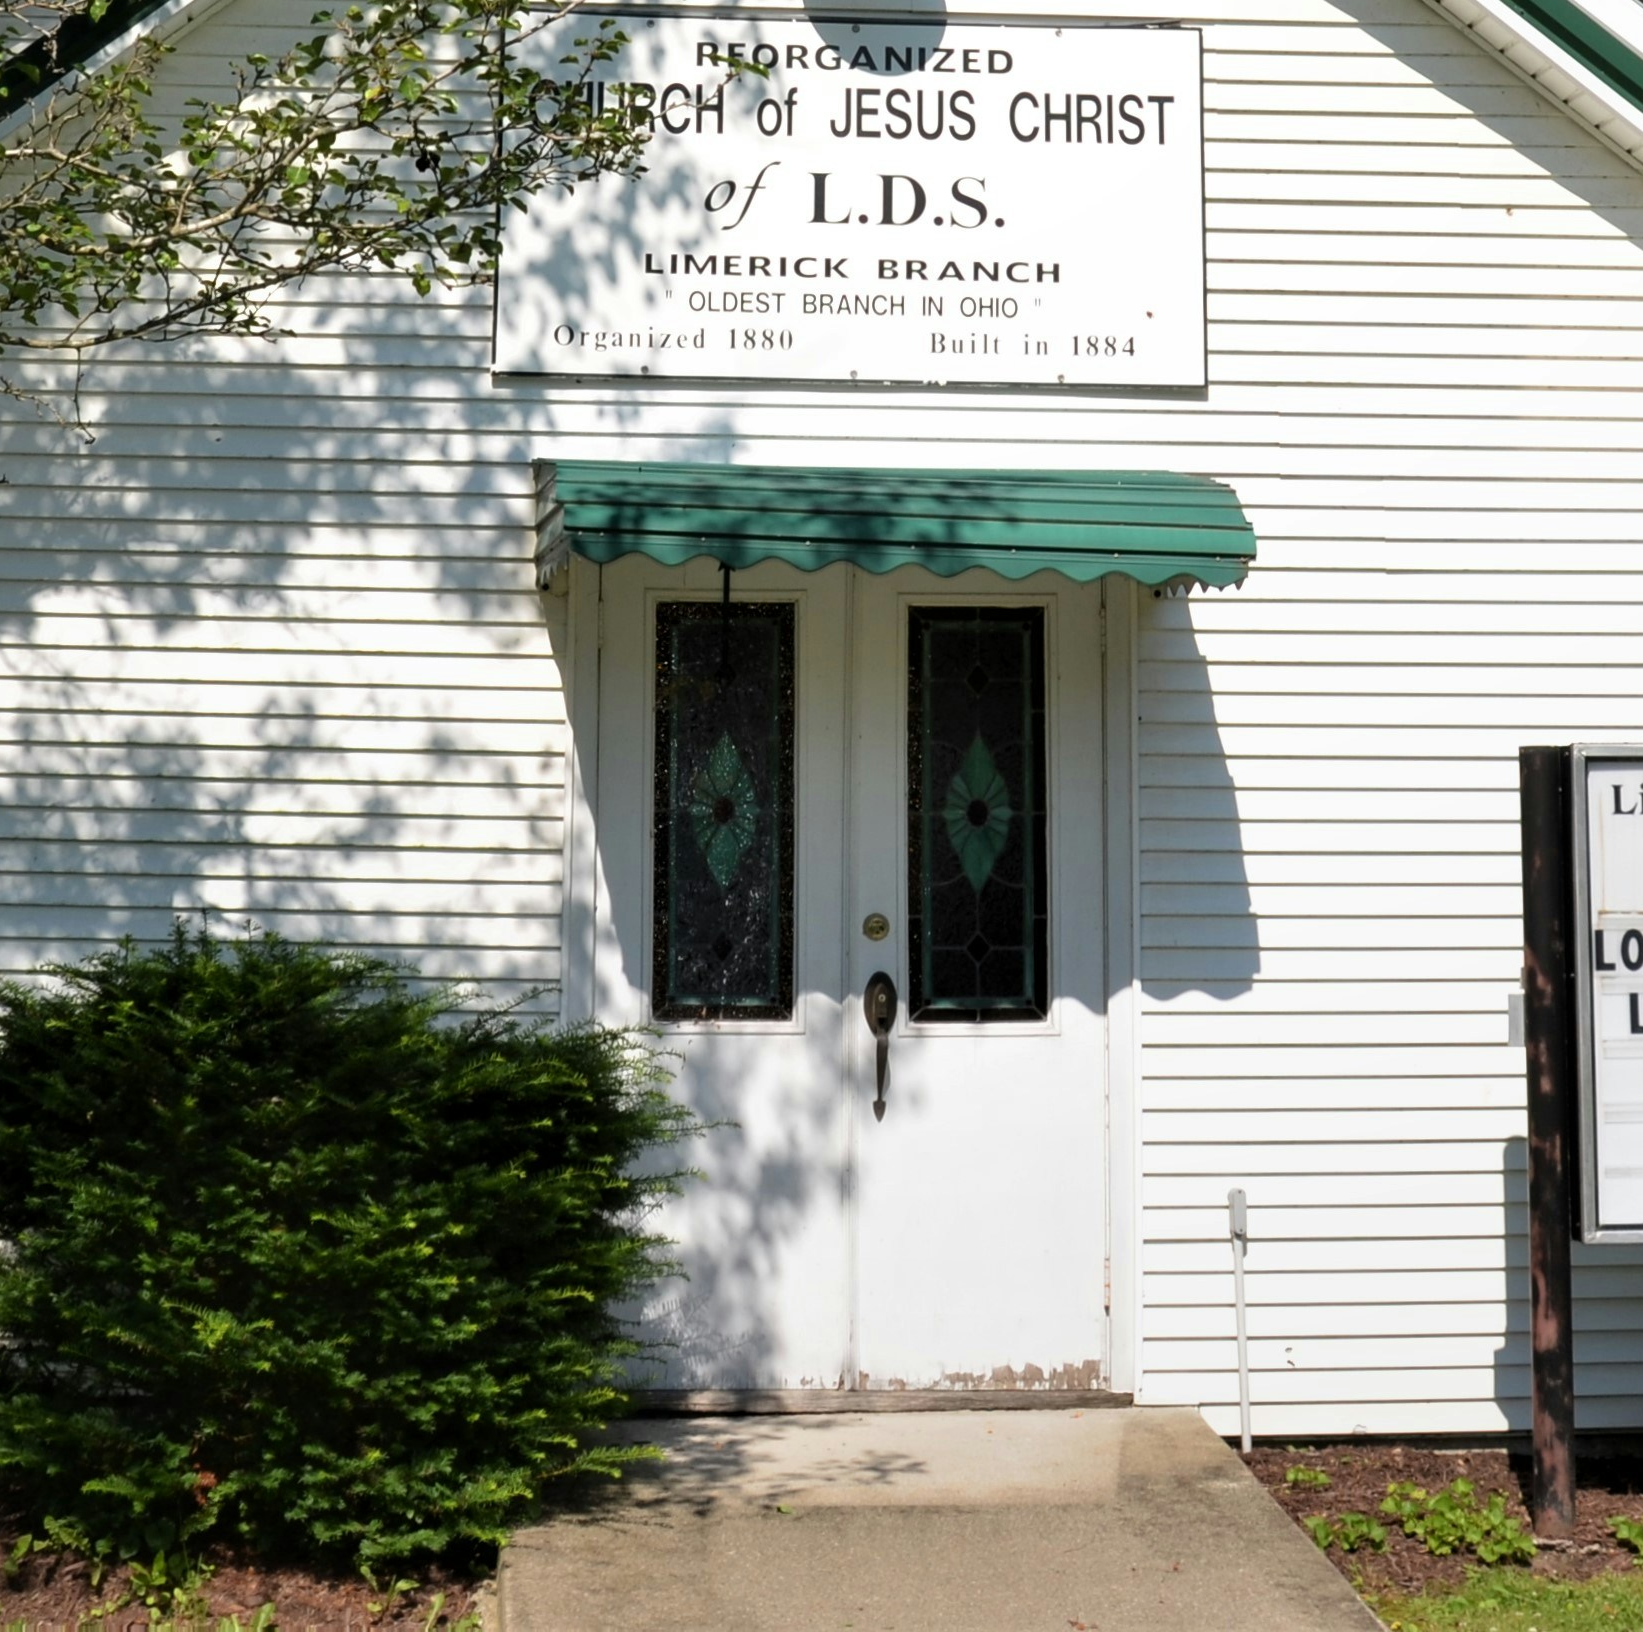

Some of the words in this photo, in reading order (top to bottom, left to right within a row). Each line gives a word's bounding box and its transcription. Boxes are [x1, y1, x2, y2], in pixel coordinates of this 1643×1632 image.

[696, 42, 1015, 74] REORGANIZED
[756, 87, 798, 137] of
[829, 88, 976, 142] JESUS
[1008, 91, 1175, 145] CHRIST
[703, 161, 782, 231] of
[808, 171, 1007, 229] L.D.S.
[642, 252, 849, 280] LIMERICK
[877, 257, 1060, 284] BRANCH
[688, 290, 787, 315] OLDEST
[802, 292, 906, 317] BRANCH
[921, 294, 945, 318] IN
[959, 296, 1019, 319] OHIO
[553, 322, 706, 352] Organized
[729, 327, 794, 351] 1880
[930, 332, 1000, 356] Built
[1023, 334, 1050, 357] in
[1071, 334, 1137, 358] 1884
